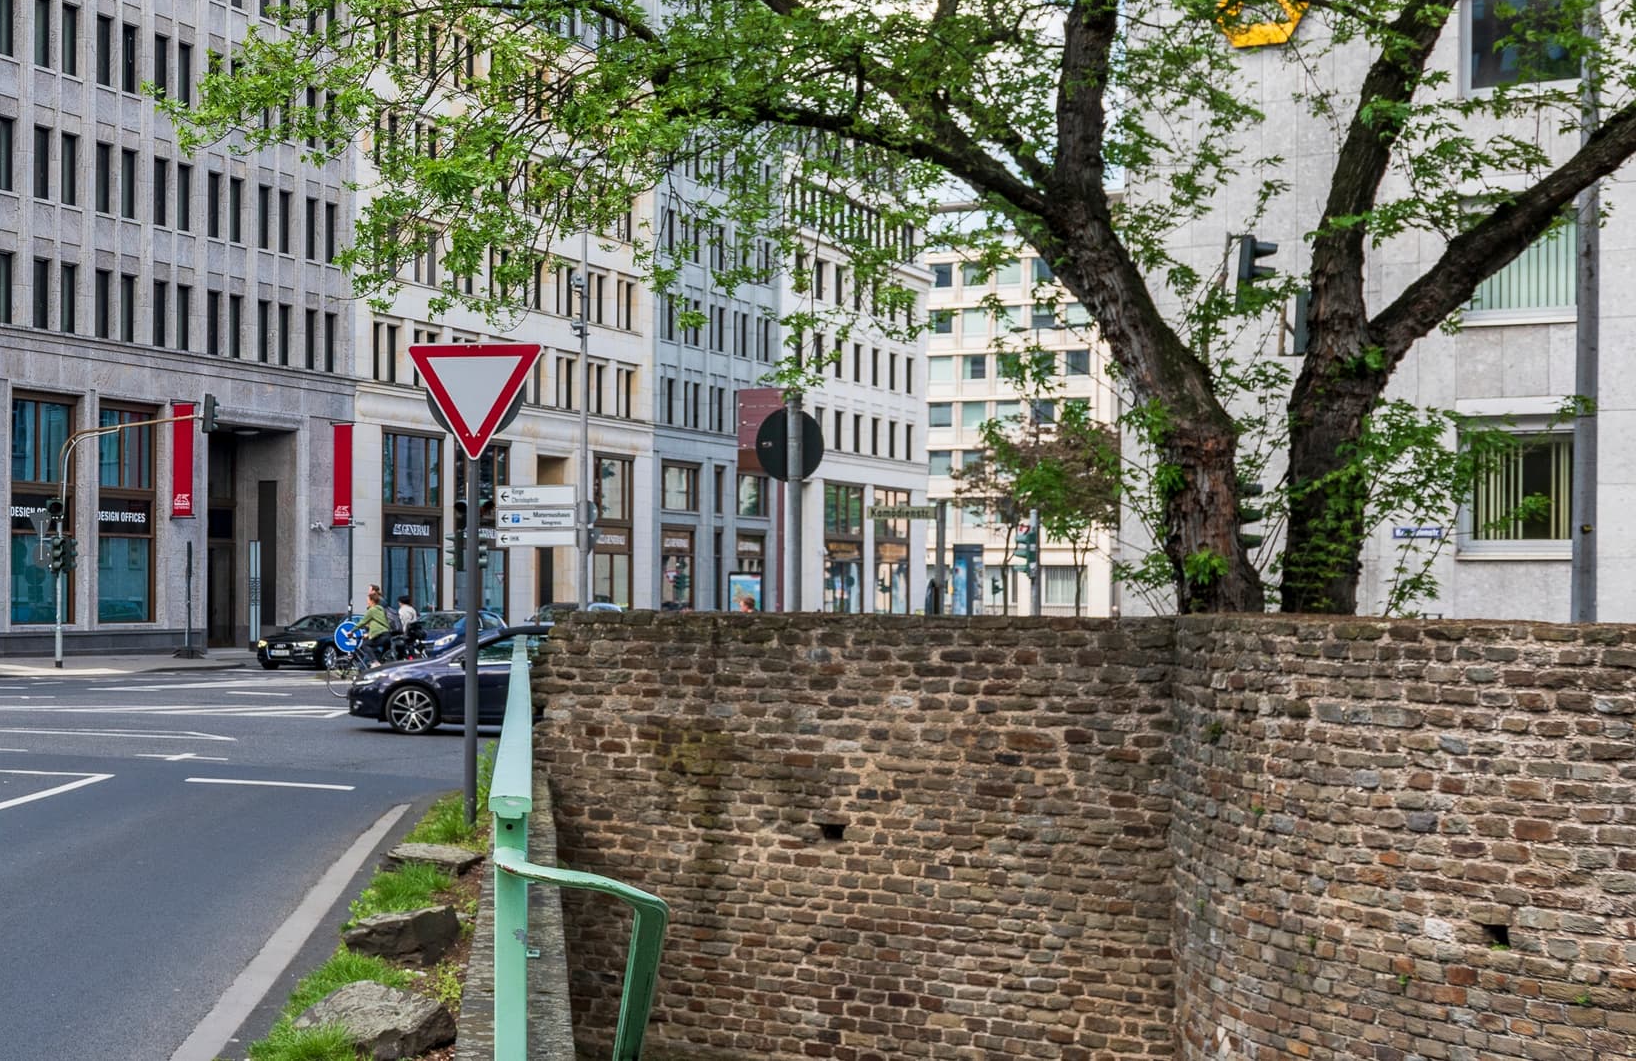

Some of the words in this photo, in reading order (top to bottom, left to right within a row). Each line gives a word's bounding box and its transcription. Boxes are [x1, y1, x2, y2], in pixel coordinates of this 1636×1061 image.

[10, 506, 36, 517] DESIGN
[120, 511, 146, 523] OFFICES
[870, 508, 931, 518] Komödienstr.
[401, 524, 430, 537] GENERALI
